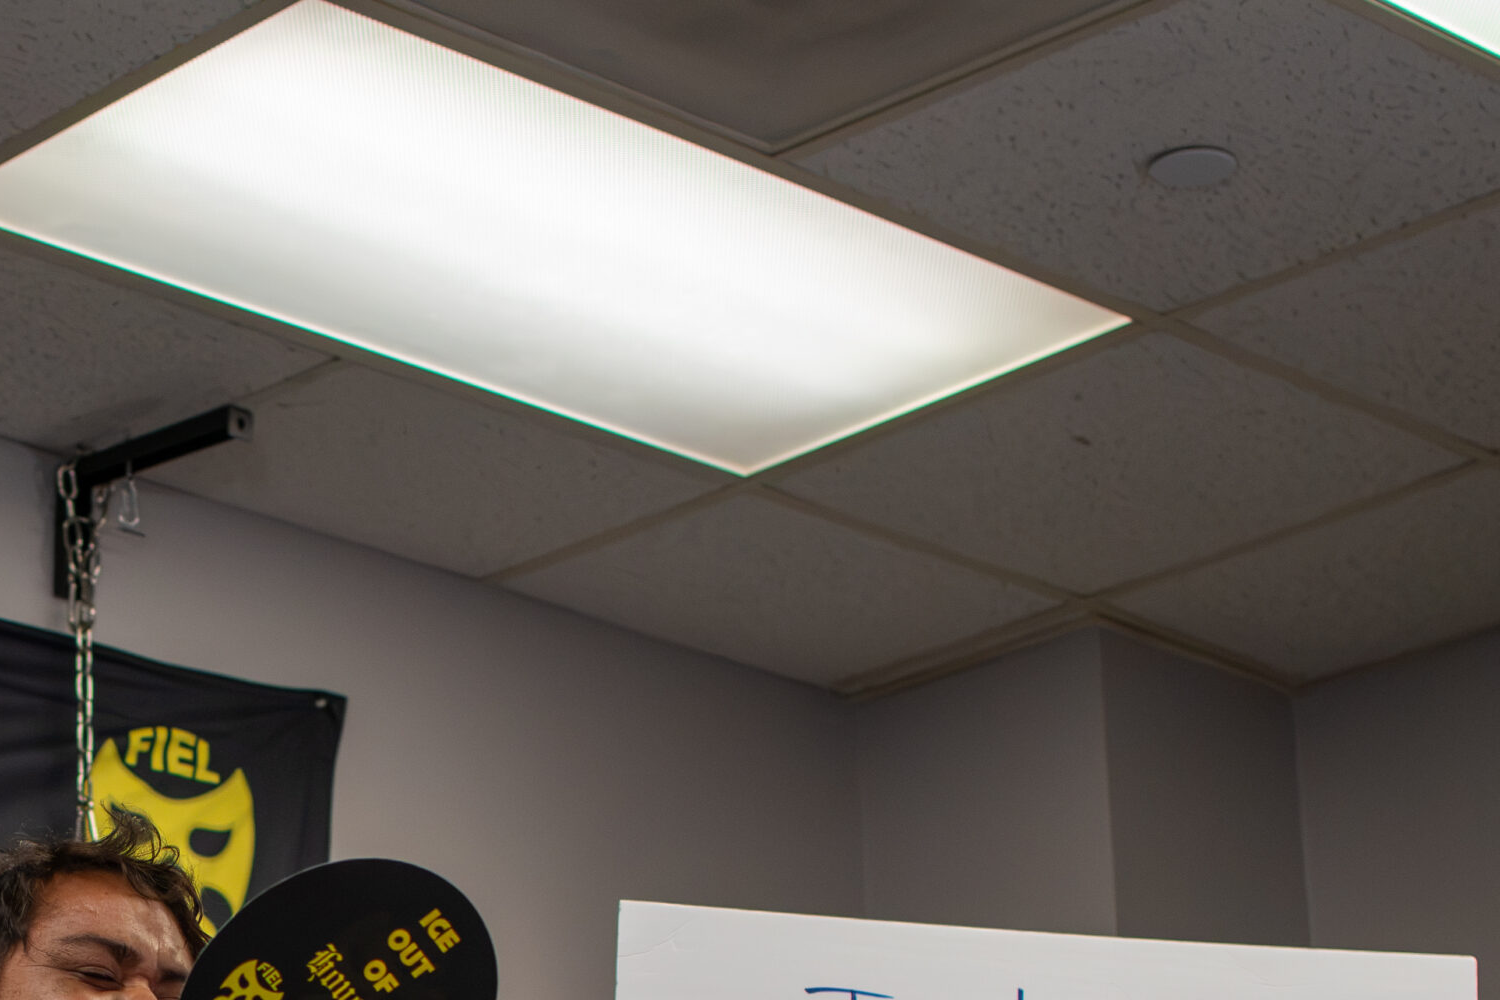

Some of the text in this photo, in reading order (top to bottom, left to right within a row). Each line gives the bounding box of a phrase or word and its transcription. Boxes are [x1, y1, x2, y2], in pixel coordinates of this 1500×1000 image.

[124, 725, 220, 786] FIEL
[419, 907, 461, 953] ICE
[257, 962, 282, 991] FIEL
[363, 959, 400, 993] OF
[387, 928, 436, 979] OUT
